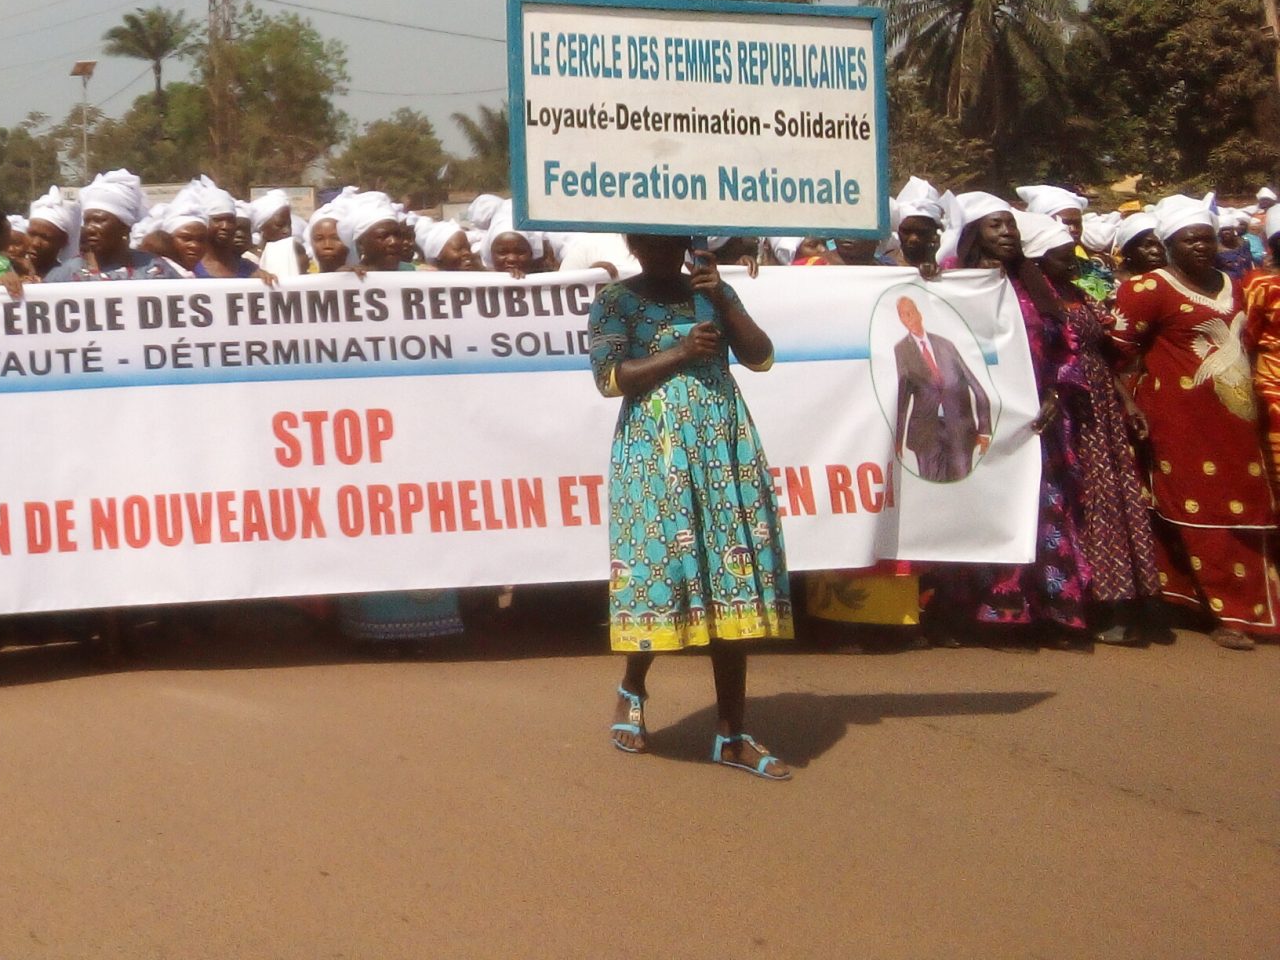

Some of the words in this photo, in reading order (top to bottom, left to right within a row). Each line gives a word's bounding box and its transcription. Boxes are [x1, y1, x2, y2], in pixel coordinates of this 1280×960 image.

[530, 31, 551, 76] LE
[556, 33, 622, 79] CERCLE
[627, 35, 660, 81] DES
[664, 37, 732, 84] FEMMES
[737, 41, 868, 91] REPUBLICAINES
[543, 160, 707, 200] Federation
[718, 166, 861, 205] Nationale
[138, 293, 213, 329] DES
[227, 288, 389, 326] FEMMES
[401, 283, 606, 321] REPUBLIC
[144, 332, 453, 370] DÉTERMINATION
[272, 408, 394, 468] STOP
[24, 499, 77, 554] DE
[90, 487, 327, 550] NOUVEAUX
[337, 477, 547, 538] ORPHELIN
[558, 474, 604, 527] ET
